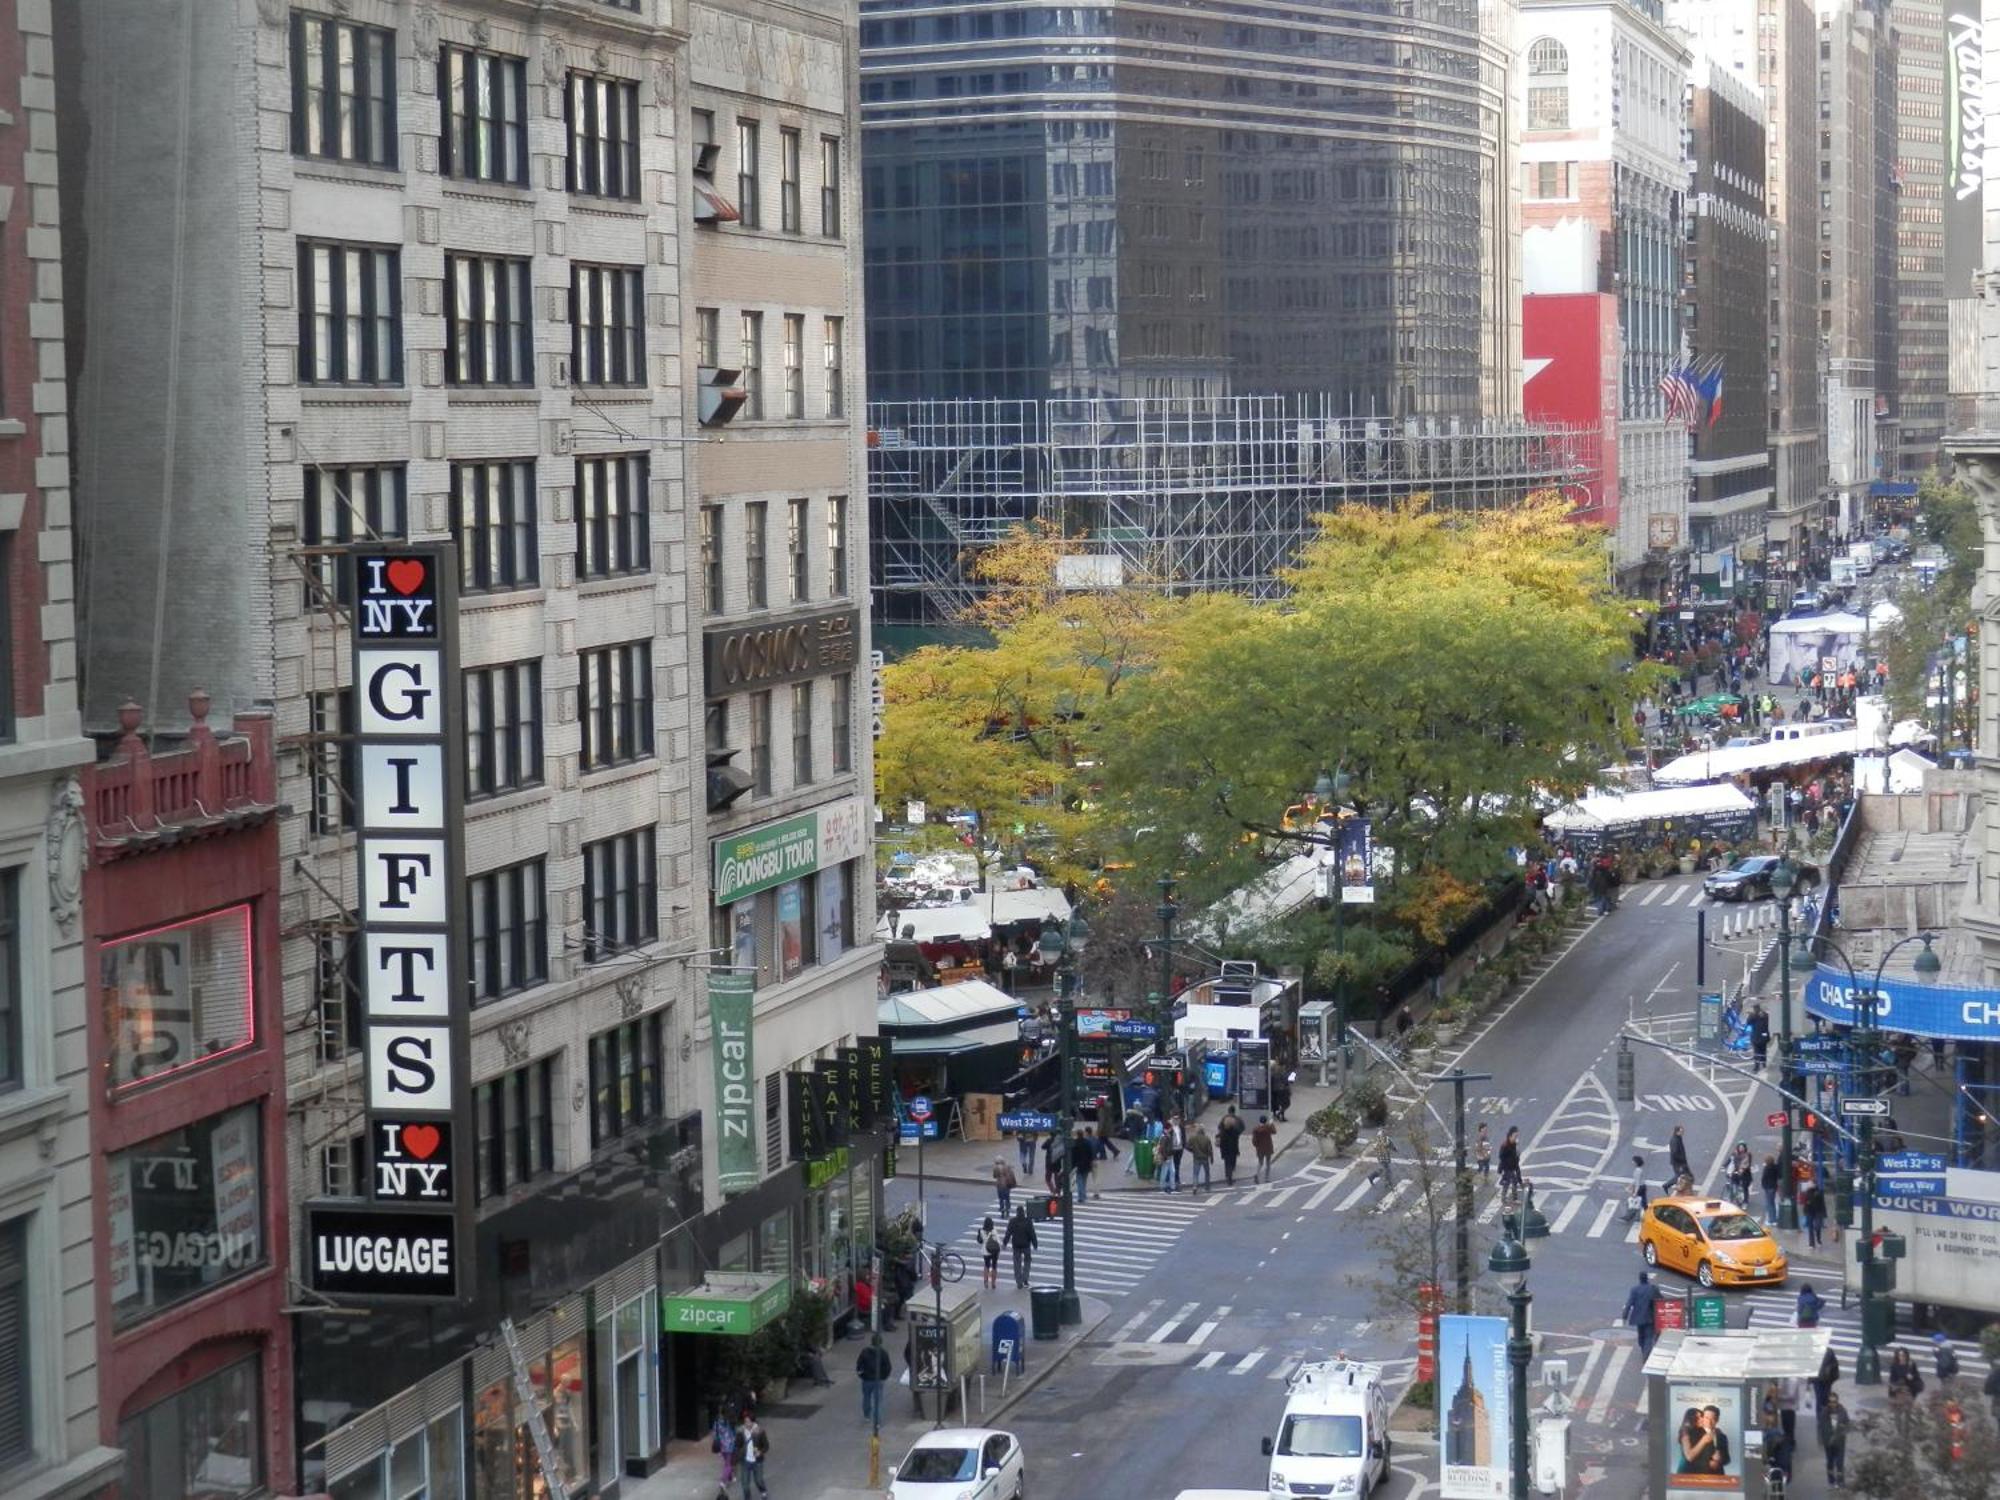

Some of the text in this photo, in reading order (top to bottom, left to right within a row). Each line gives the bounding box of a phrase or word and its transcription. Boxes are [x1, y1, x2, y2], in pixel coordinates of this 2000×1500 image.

[368, 561, 387, 593] I
[362, 599, 433, 633] NY
[722, 624, 809, 684] COSMOS
[368, 662, 436, 1094] GIFTS
[736, 847, 784, 889] DONGBU
[784, 838, 814, 870] TOUR
[1114, 1024, 1132, 1034] West
[1147, 1025, 1156, 1035] St
[718, 1020, 753, 1139] zipcar
[848, 1053, 859, 1129] DRINK
[869, 1045, 881, 1113] MEET
[825, 1069, 839, 1126] EAT
[800, 1074, 812, 1161] NATURAL
[1000, 1117, 1023, 1128] West
[1042, 1118, 1052, 1128] St
[383, 1125, 401, 1157] I
[376, 1163, 447, 1196] NY
[1883, 1158, 1908, 1169] West
[1931, 1159, 1941, 1169] St
[1889, 1181, 1915, 1190] Korea
[1915, 1181, 1936, 1192] Way
[318, 1235, 449, 1274] LUGGAGE
[680, 1304, 736, 1326] zipcar
